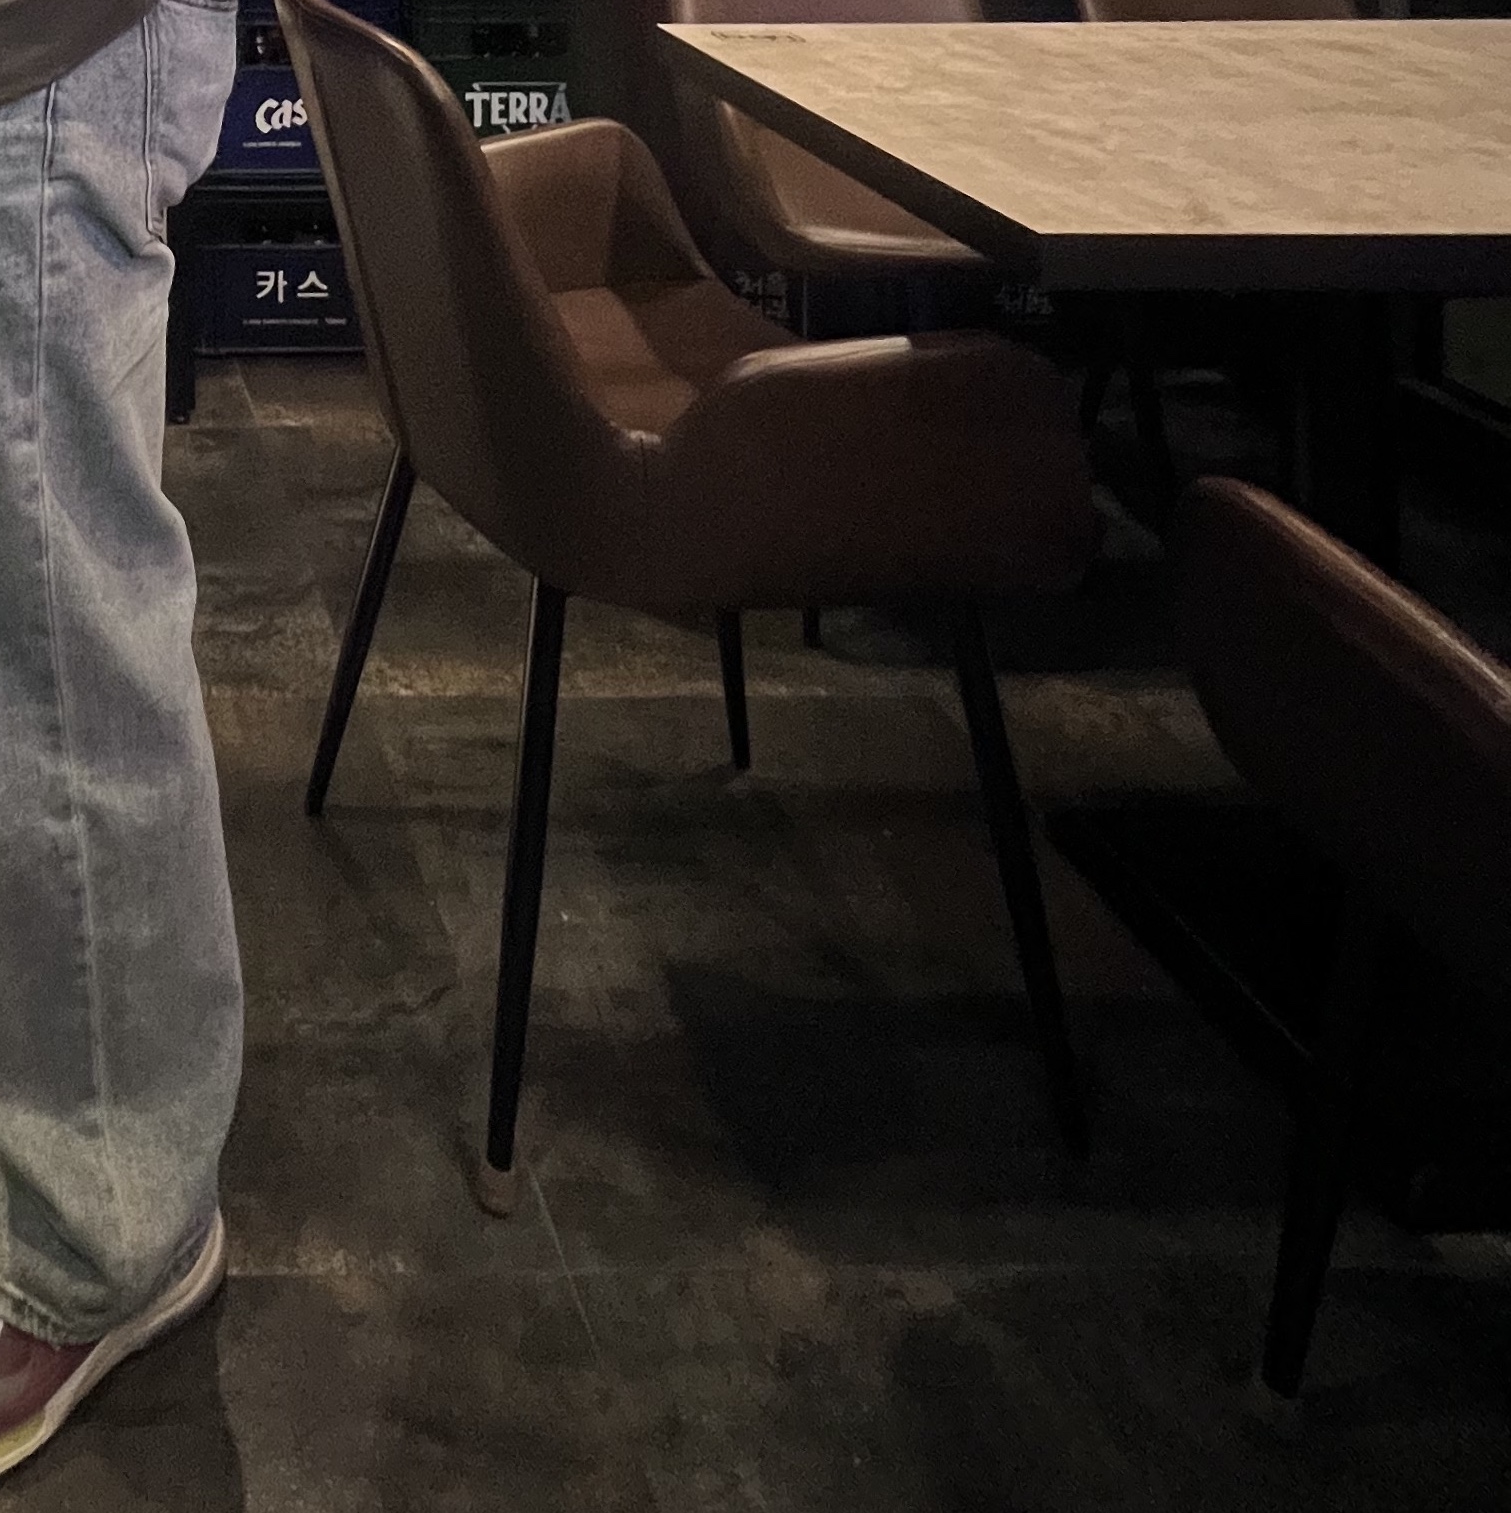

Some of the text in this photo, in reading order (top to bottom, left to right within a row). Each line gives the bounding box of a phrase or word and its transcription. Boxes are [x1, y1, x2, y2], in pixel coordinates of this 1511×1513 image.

[254, 97, 309, 134] Cas
[464, 90, 574, 128] TERRA
[255, 269, 330, 304] 카스
